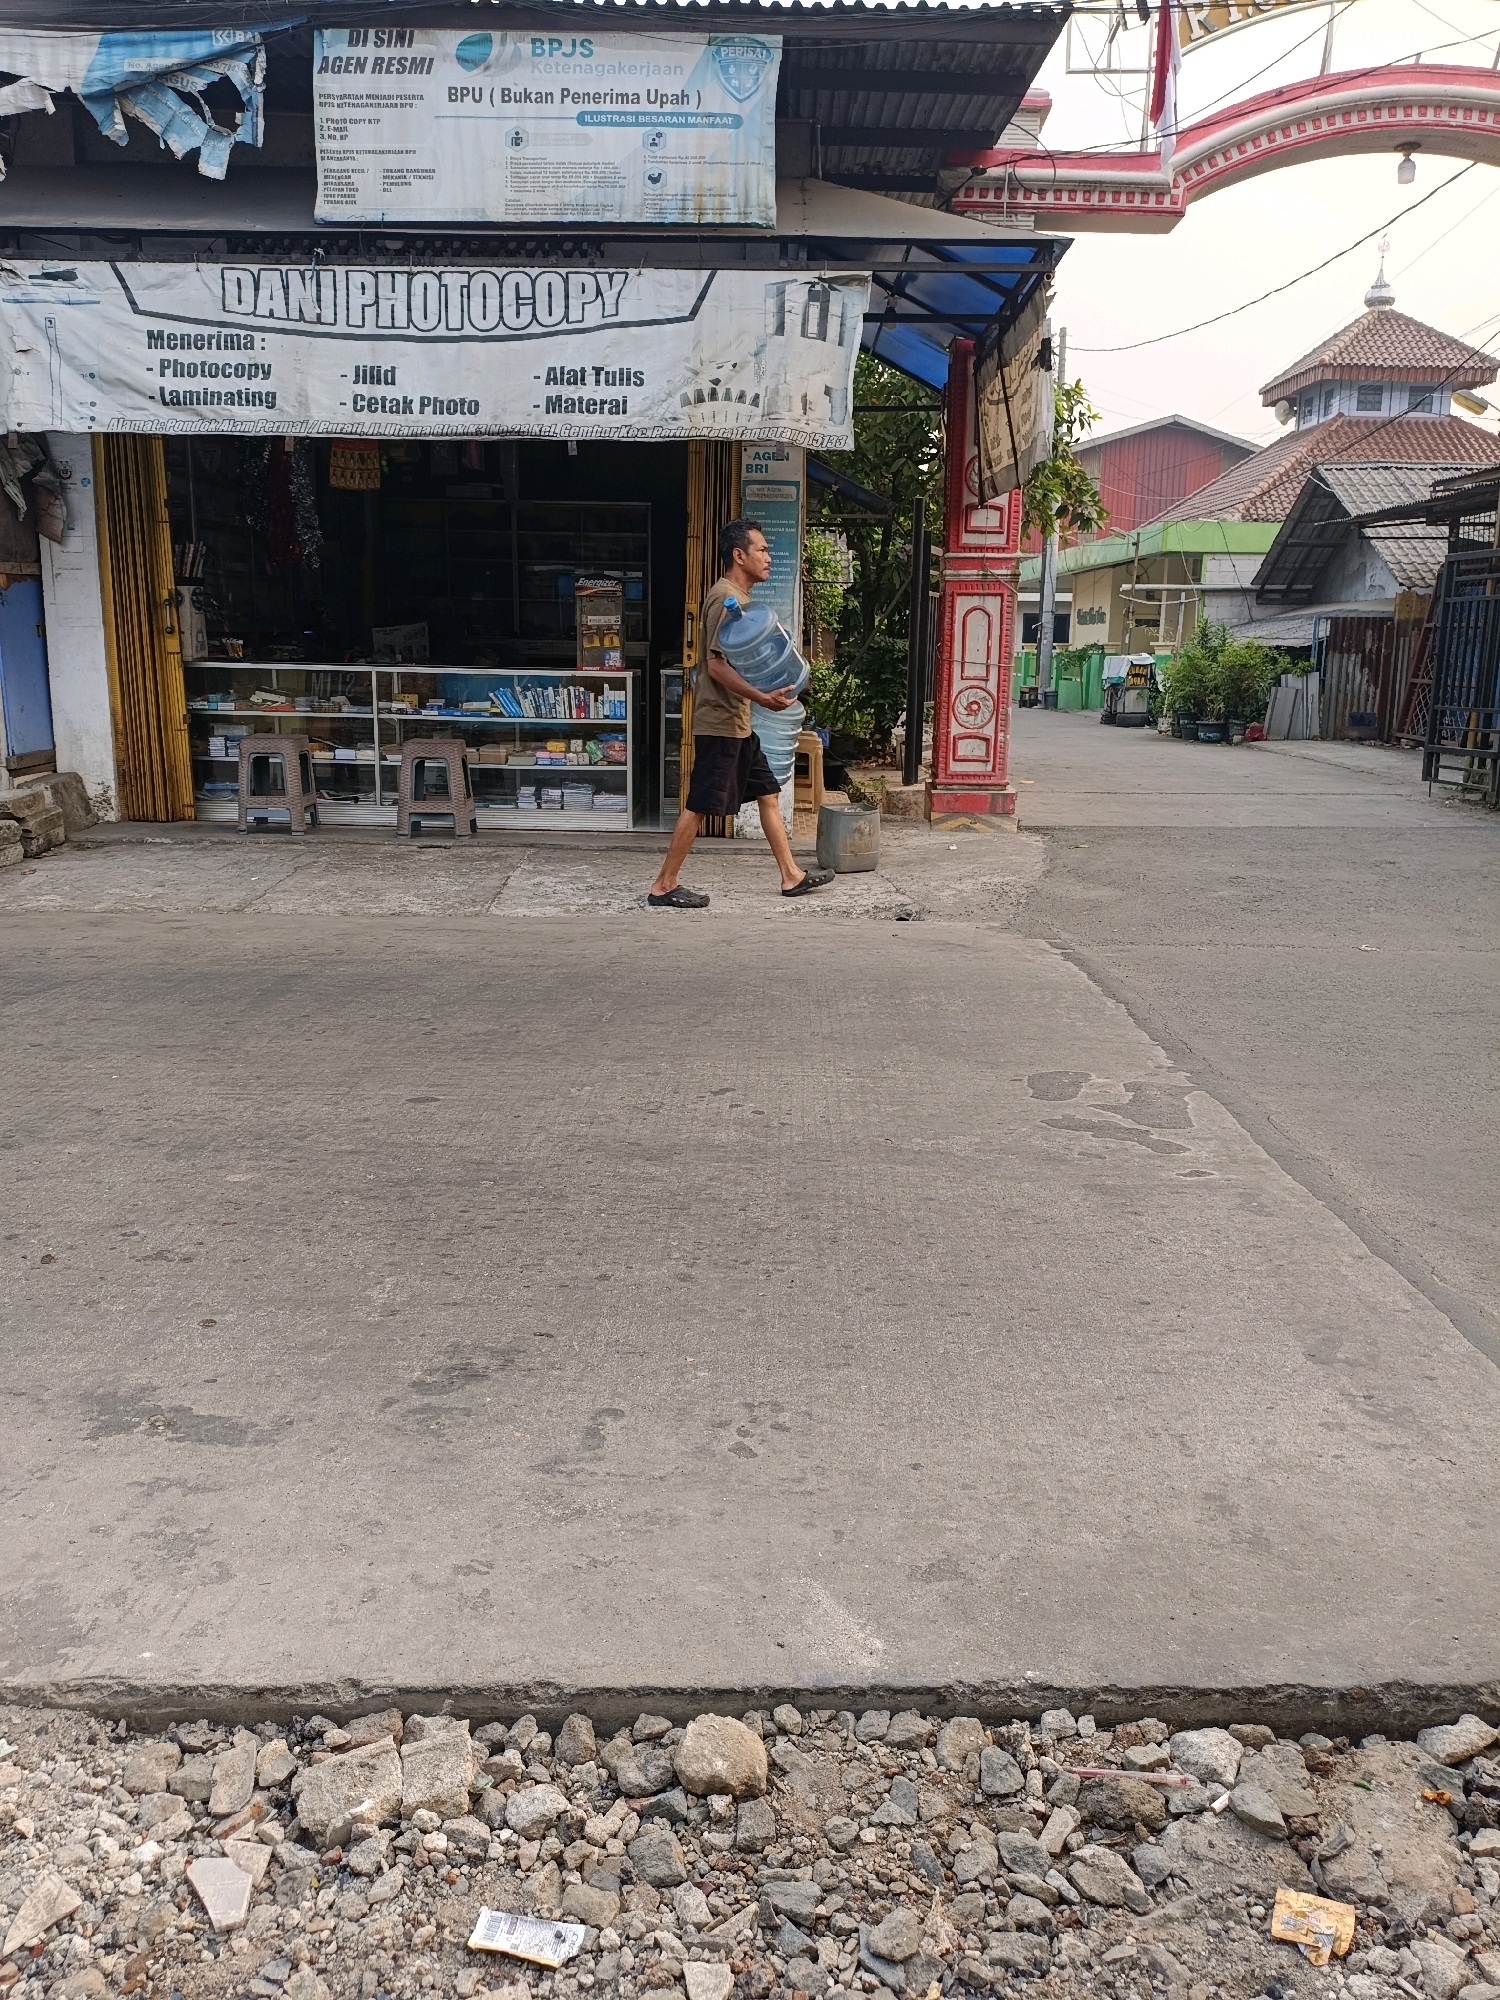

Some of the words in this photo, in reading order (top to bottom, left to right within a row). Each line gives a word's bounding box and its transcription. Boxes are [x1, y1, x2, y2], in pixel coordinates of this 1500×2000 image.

[347, 29, 369, 48] DI
[373, 29, 415, 49] SINI
[530, 37, 594, 58] BPJS
[316, 55, 368, 75] AGEN
[370, 57, 435, 76] RESMI
[530, 60, 684, 78] Ketenagakerjaan
[318, 93, 364, 101] PERSYARATAN
[365, 93, 395, 101] MENJADI
[447, 86, 483, 104] BPU
[501, 87, 554, 105] Bukan
[560, 88, 641, 105] Penerima
[646, 89, 690, 109] Upah
[325, 117, 348, 125] PHOTO
[327, 125, 349, 133] E-MAIL
[583, 114, 636, 124] ILUSTRASI
[638, 114, 686, 125] BESARAN
[687, 115, 734, 126] MANFAAT
[220, 266, 337, 325] DANI
[345, 269, 629, 332] PHOTOCOPY
[146, 329, 255, 351] Menerima
[158, 358, 272, 381] Photocopy
[352, 364, 397, 386] Jilid
[544, 364, 589, 387] Alat
[590, 365, 646, 388] Tulis
[158, 386, 277, 409] Laminating
[352, 392, 414, 416] Cetak
[418, 395, 480, 416] Photo
[544, 394, 629, 416] Materai
[165, 419, 219, 433] Pondok
[218, 419, 255, 433] Alam
[256, 419, 308, 435] Permai
[383, 422, 432, 437] Utama
[432, 423, 466, 437] Blok
[700, 426, 735, 439] Kota
[735, 426, 809, 447] Tangerang
[745, 463, 769, 474] BRI
[577, 577, 619, 589] Energizer
